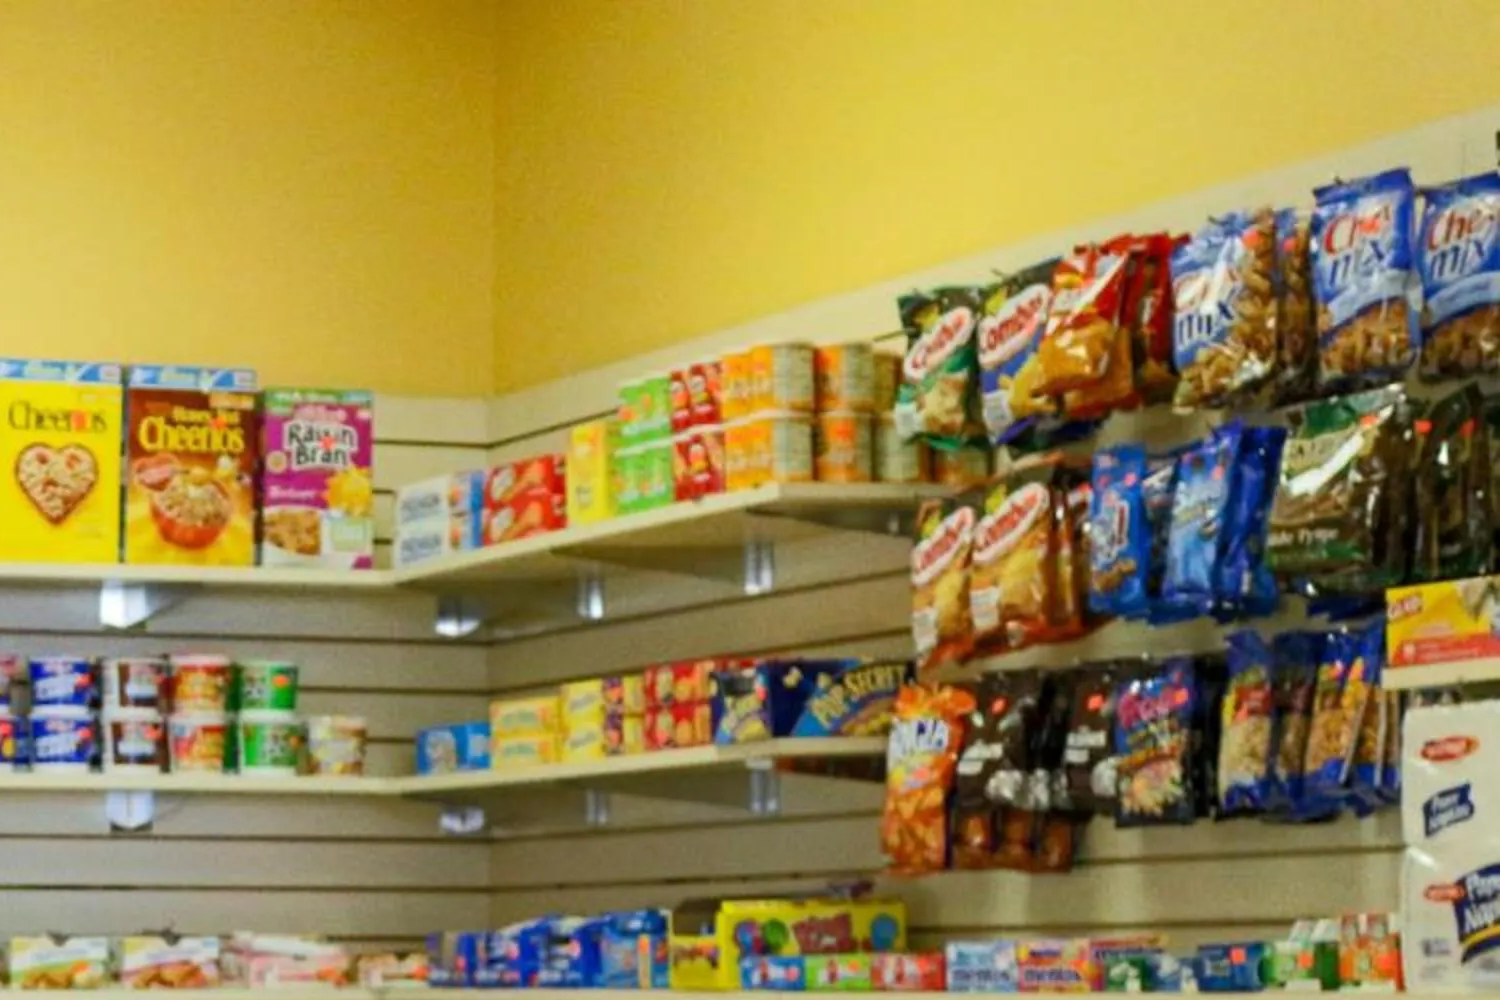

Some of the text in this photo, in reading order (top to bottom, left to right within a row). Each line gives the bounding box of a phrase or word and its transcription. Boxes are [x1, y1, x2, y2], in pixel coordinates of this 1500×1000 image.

[1430, 238, 1486, 278] mix
[138, 415, 245, 453] Cheerios
[296, 448, 347, 466] Bran
